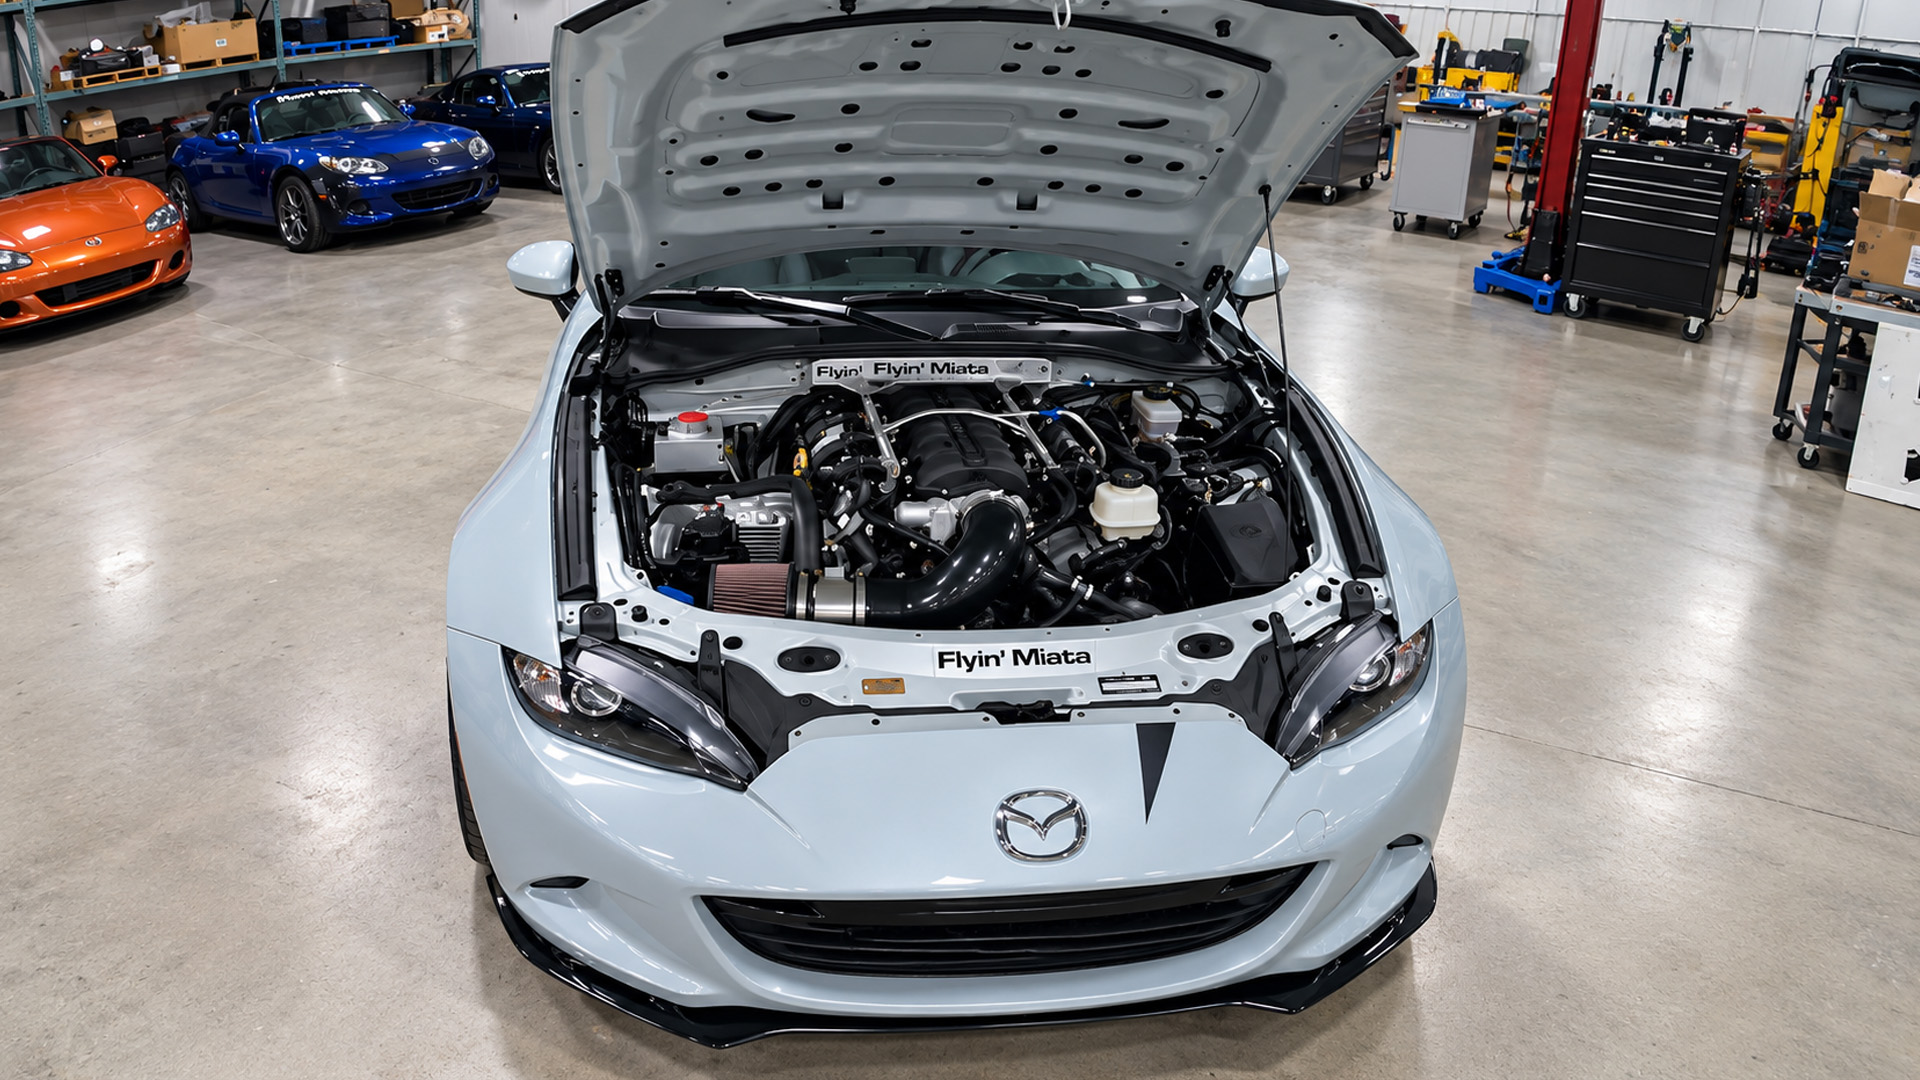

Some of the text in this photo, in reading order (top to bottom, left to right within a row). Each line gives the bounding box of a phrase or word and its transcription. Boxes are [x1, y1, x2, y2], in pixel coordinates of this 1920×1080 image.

[874, 362, 924, 378] Flyin'
[931, 362, 989, 375] Miata
[938, 648, 1091, 672] Flyin' Miata
